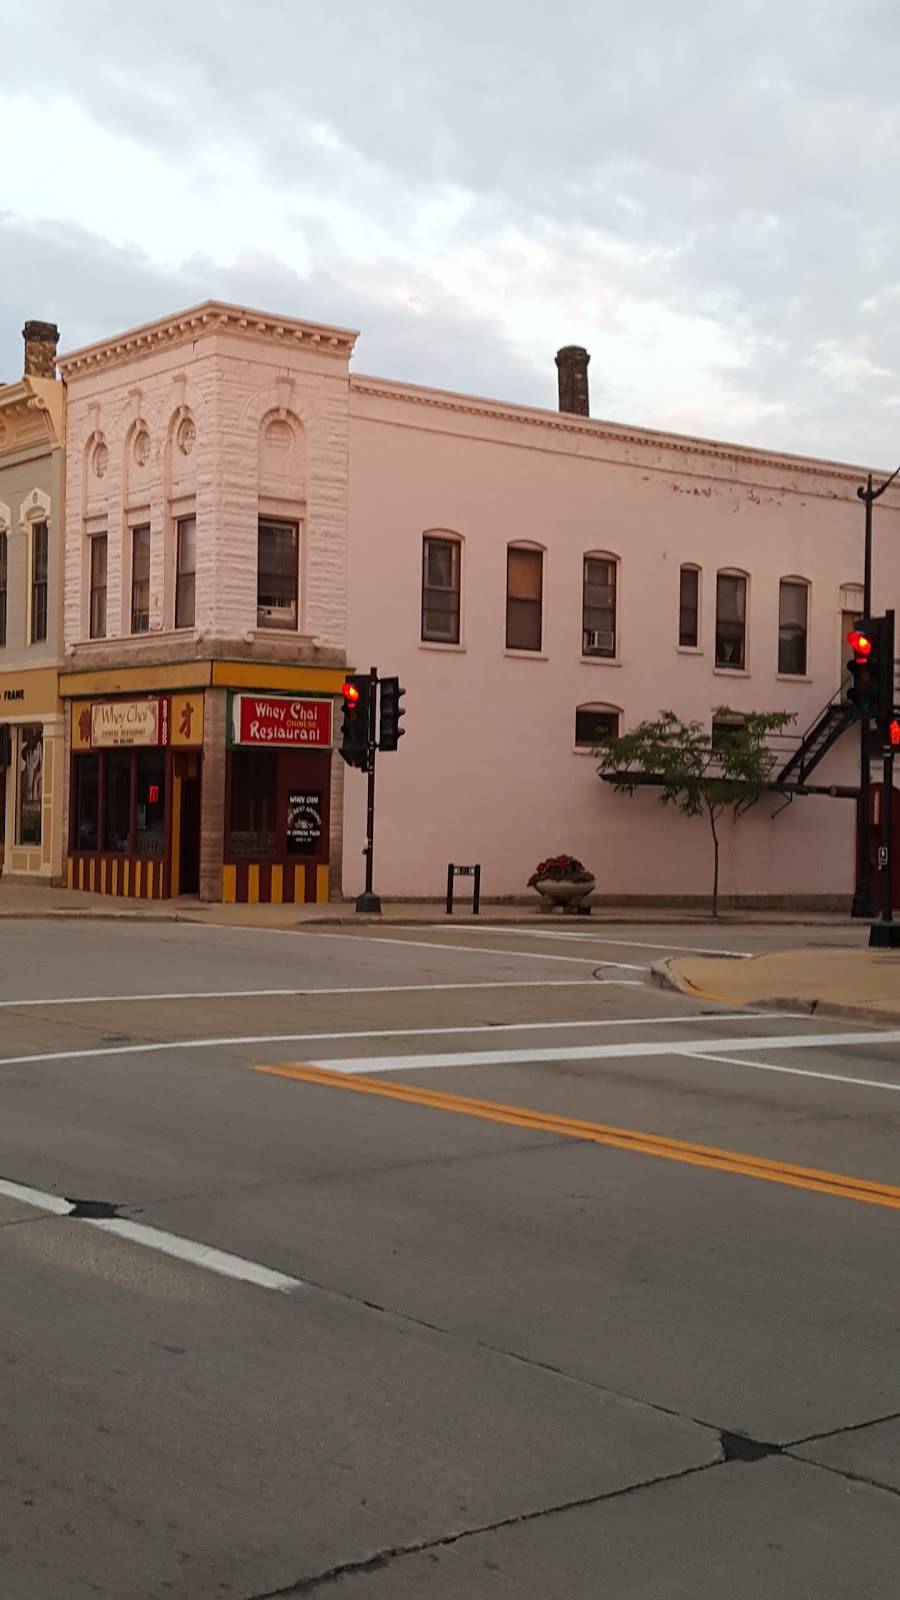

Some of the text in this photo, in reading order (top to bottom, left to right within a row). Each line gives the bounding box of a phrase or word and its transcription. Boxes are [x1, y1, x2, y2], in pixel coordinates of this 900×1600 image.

[4, 689, 24, 701] FRAME
[255, 701, 318, 721] Whey Chai
[249, 720, 320, 741] Restaurant
[286, 720, 317, 729] CHINESE
